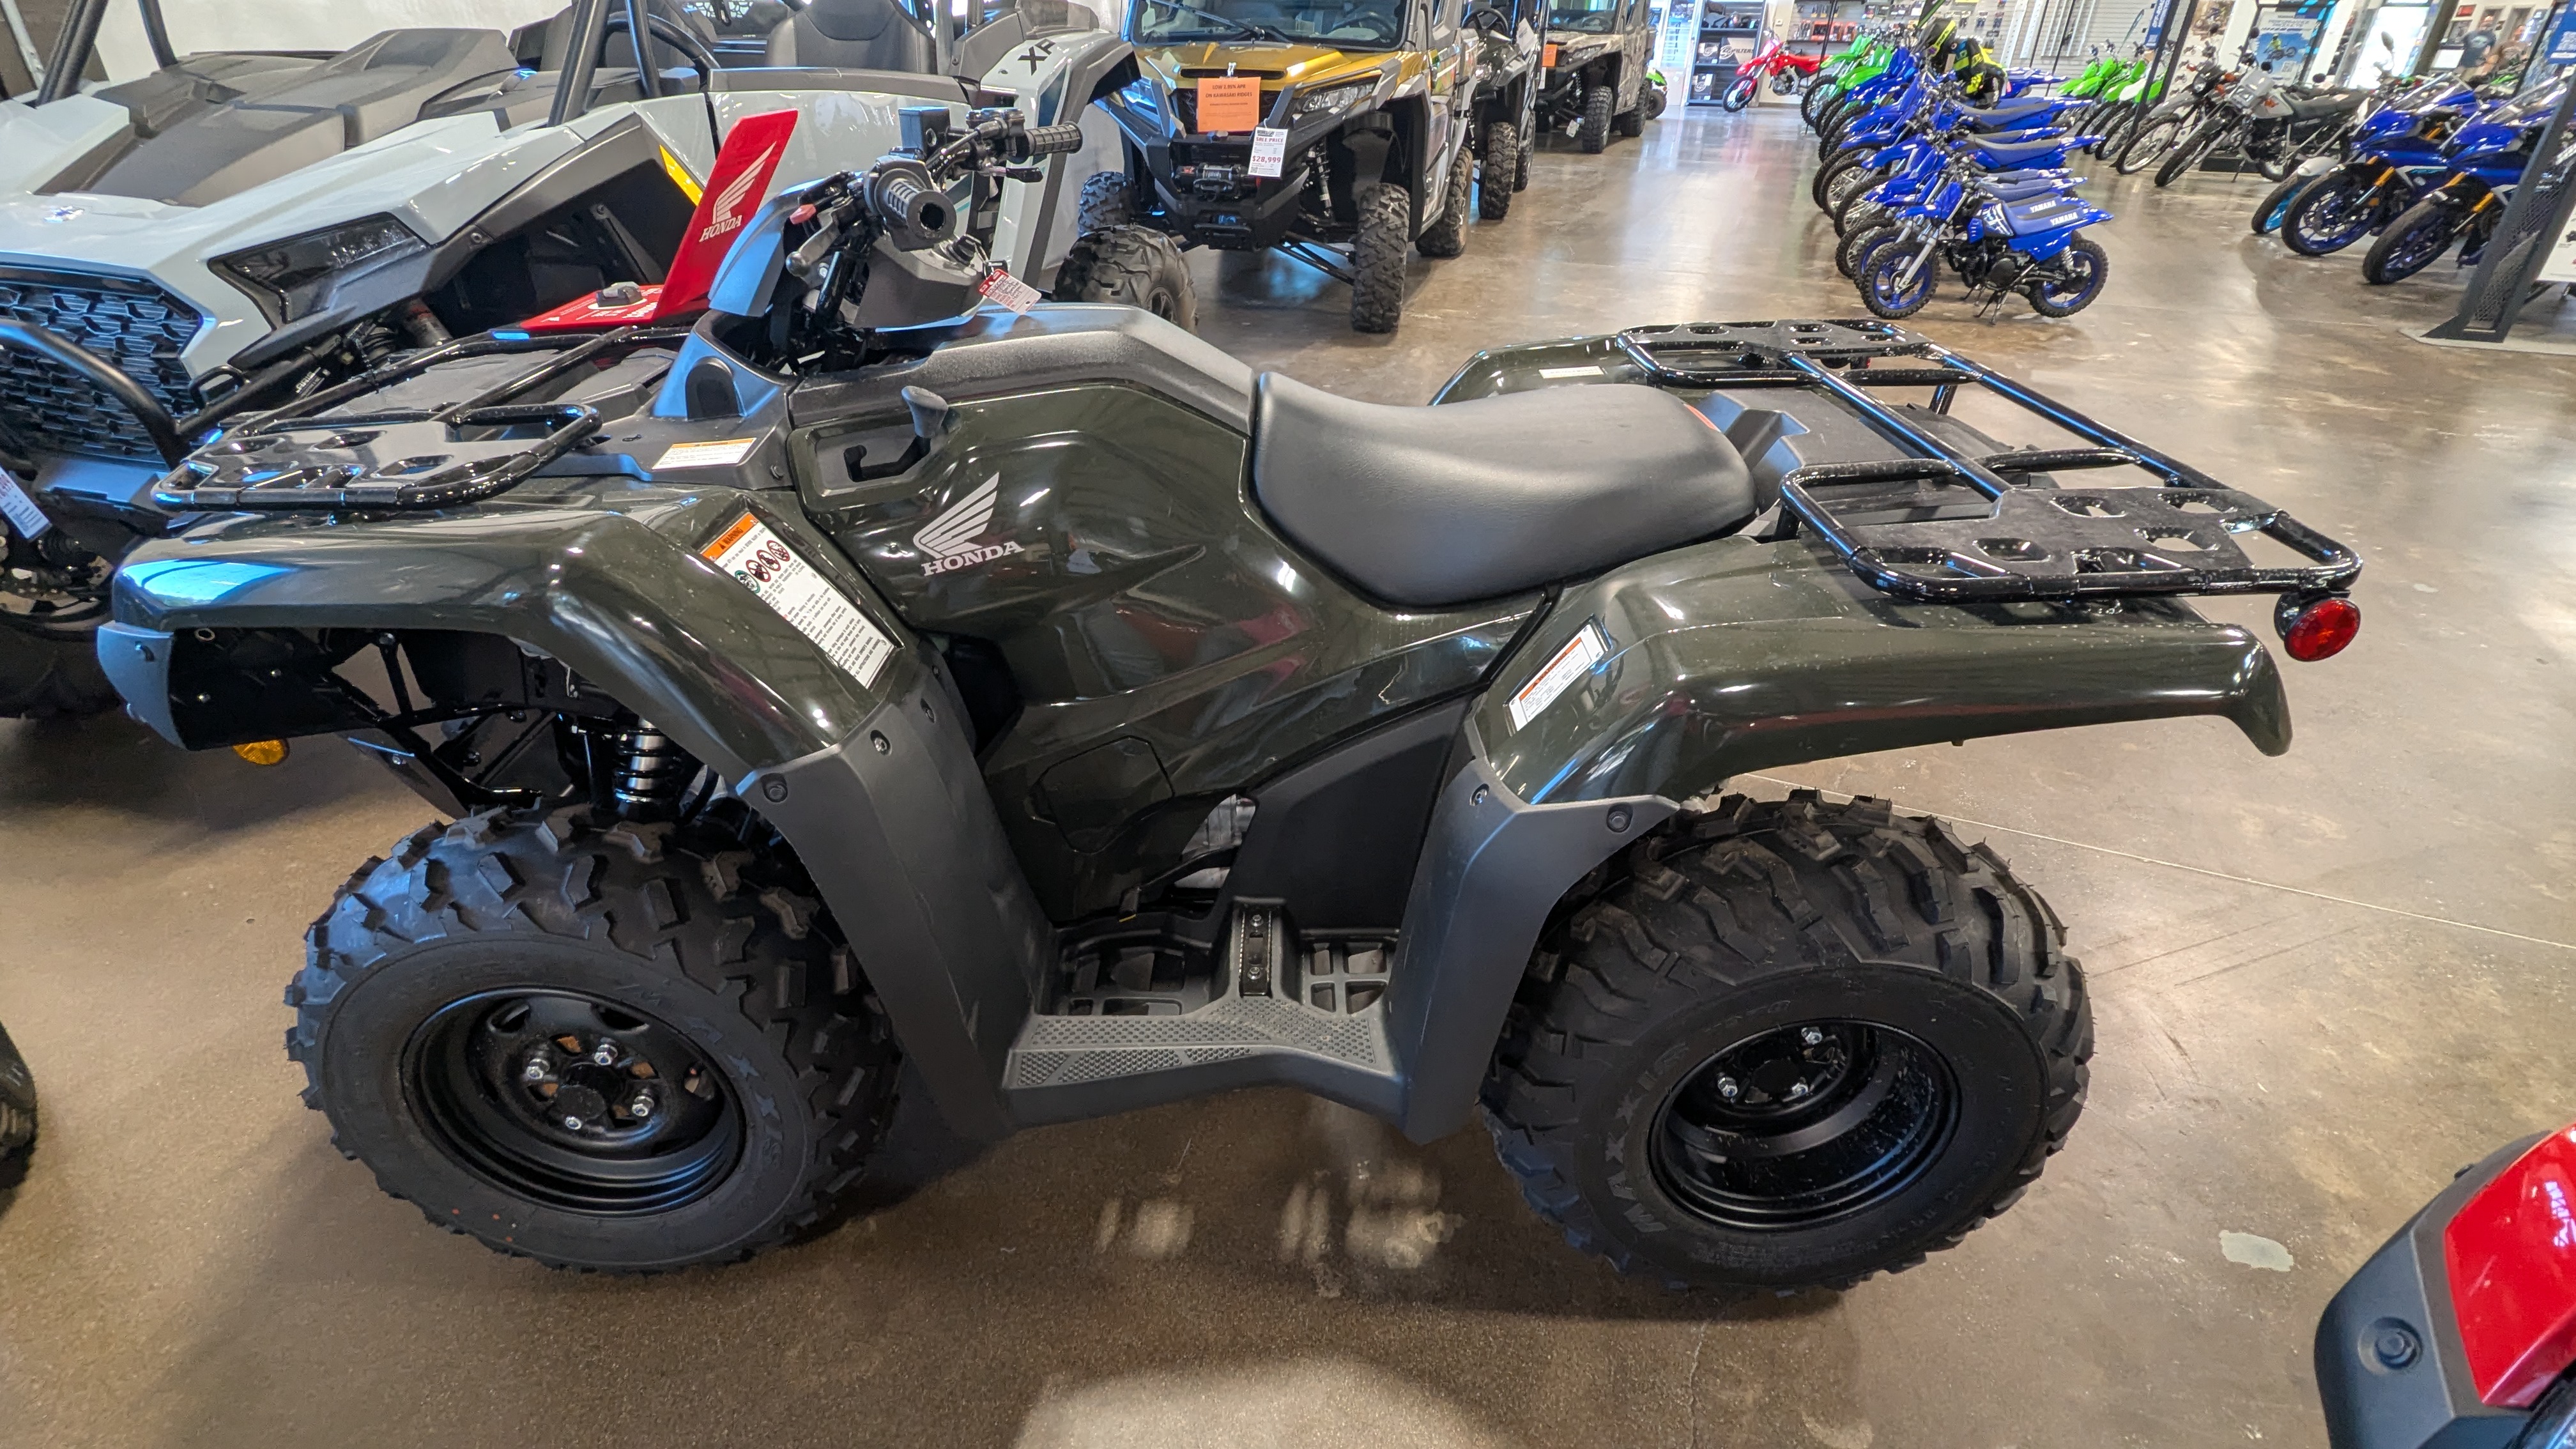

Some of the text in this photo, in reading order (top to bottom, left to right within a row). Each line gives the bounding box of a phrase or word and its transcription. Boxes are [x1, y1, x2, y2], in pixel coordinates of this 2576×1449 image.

[1017, 38, 1056, 75] XP
[1252, 155, 1282, 164] $28,999
[2030, 200, 2057, 213] YAMAHA
[699, 215, 742, 243] HONDA
[2050, 211, 2078, 226] YAMAHA
[721, 526, 744, 545] WARNING
[921, 540, 1025, 577] HONDA
[1538, 650, 1567, 681] WARNING
